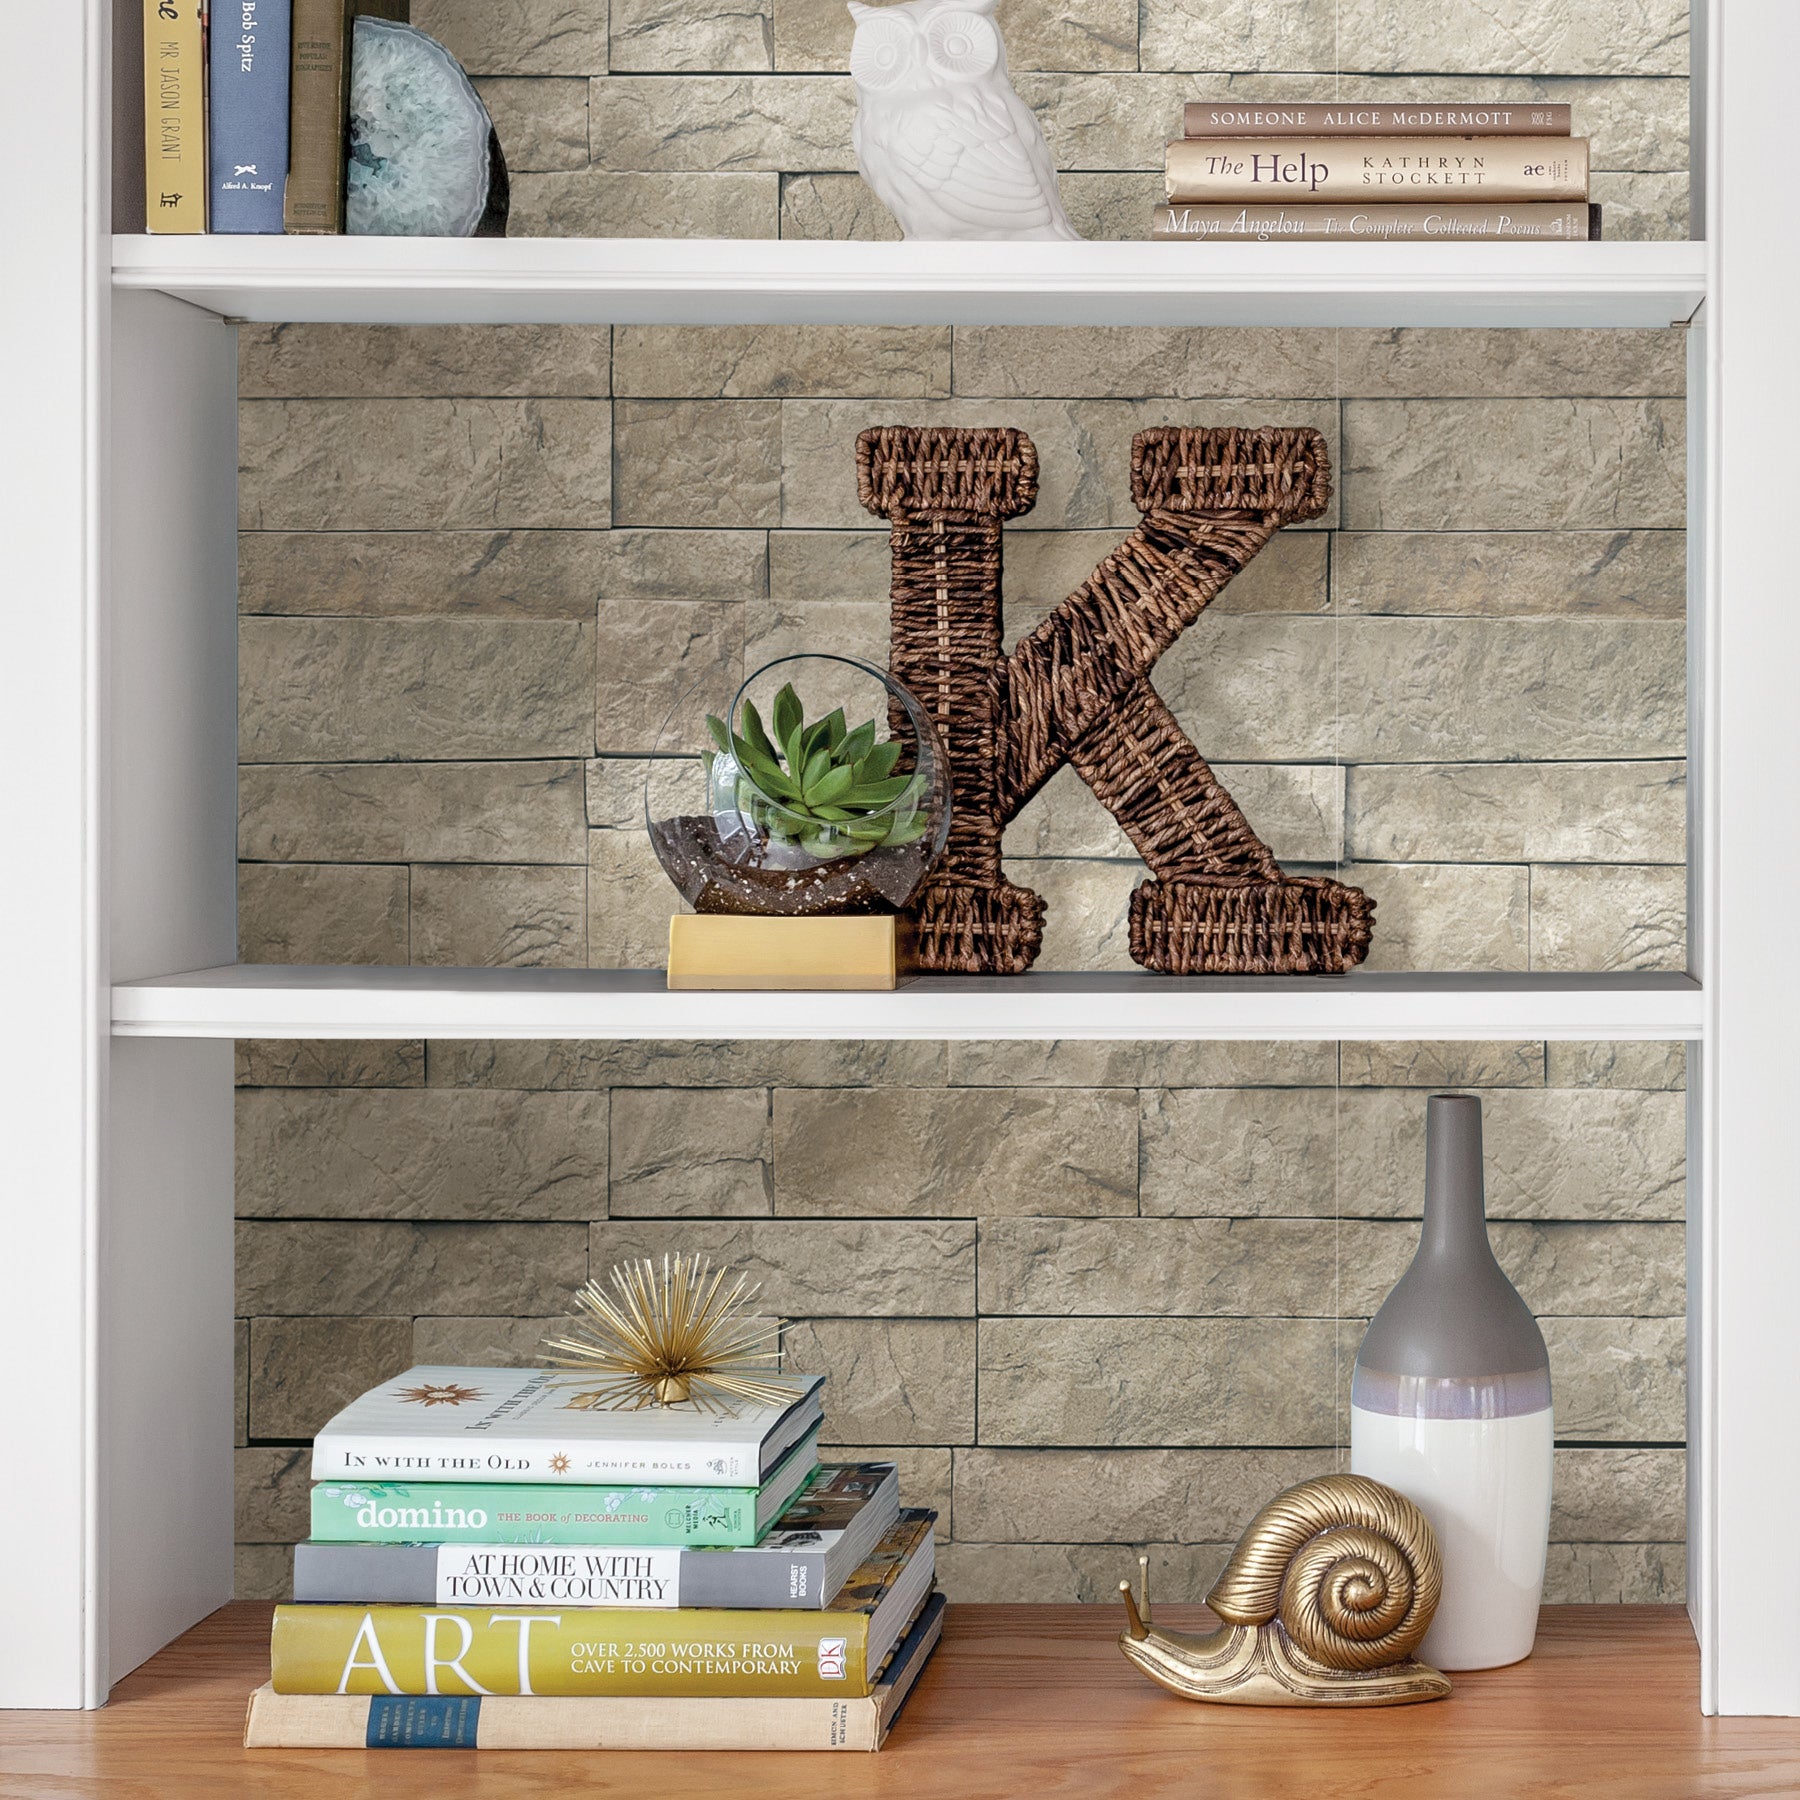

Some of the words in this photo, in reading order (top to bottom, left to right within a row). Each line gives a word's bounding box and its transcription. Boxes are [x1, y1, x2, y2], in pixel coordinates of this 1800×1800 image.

[242, 1, 257, 30] Bob
[160, 41, 179, 59] MR
[236, 34, 256, 72] Spitz
[160, 68, 180, 109] JASON
[1210, 111, 1307, 126] SOMEONE
[1323, 111, 1381, 126] ALICE
[1392, 111, 1513, 126] McDERMOTT
[161, 117, 181, 162] GRANT
[1205, 156, 1244, 175] The
[1250, 152, 1329, 192] Help
[1363, 157, 1485, 169] KATHRYN
[221, 182, 241, 190] Alfred
[250, 182, 273, 192] Knopf
[1362, 172, 1486, 185] STOCKETT
[1165, 209, 1221, 241] Maya
[1229, 209, 1306, 240] Angelou
[1349, 215, 1415, 239] Complete
[1423, 215, 1488, 235] Collected
[1496, 215, 1541, 235] Poems
[586, 1461, 646, 1469] JENNIFER
[652, 1462, 691, 1470] BOLES
[356, 1500, 488, 1529] domino
[497, 1513, 521, 1522] THE
[525, 1513, 558, 1522] BOOK
[560, 1513, 571, 1524] of
[575, 1513, 649, 1522] DECORATING
[463, 1554, 496, 1575] AT
[502, 1554, 576, 1577] HOME
[583, 1556, 654, 1577] WITH
[447, 1576, 524, 1598] TOWN
[529, 1578, 547, 1598] &
[551, 1578, 670, 1600] COUNTRY
[790, 1564, 798, 1598] HEARST
[798, 1565, 807, 1597] BOOKS
[335, 1611, 562, 1695] ART
[571, 1643, 619, 1658] OVER
[624, 1643, 666, 1660] 2,500
[671, 1643, 735, 1658] WORKS
[742, 1644, 795, 1658] FROM
[820, 1643, 840, 1675] DK
[571, 1659, 615, 1673] CAVE
[621, 1660, 646, 1674] TO
[651, 1660, 801, 1675] CONTEMPORARY
